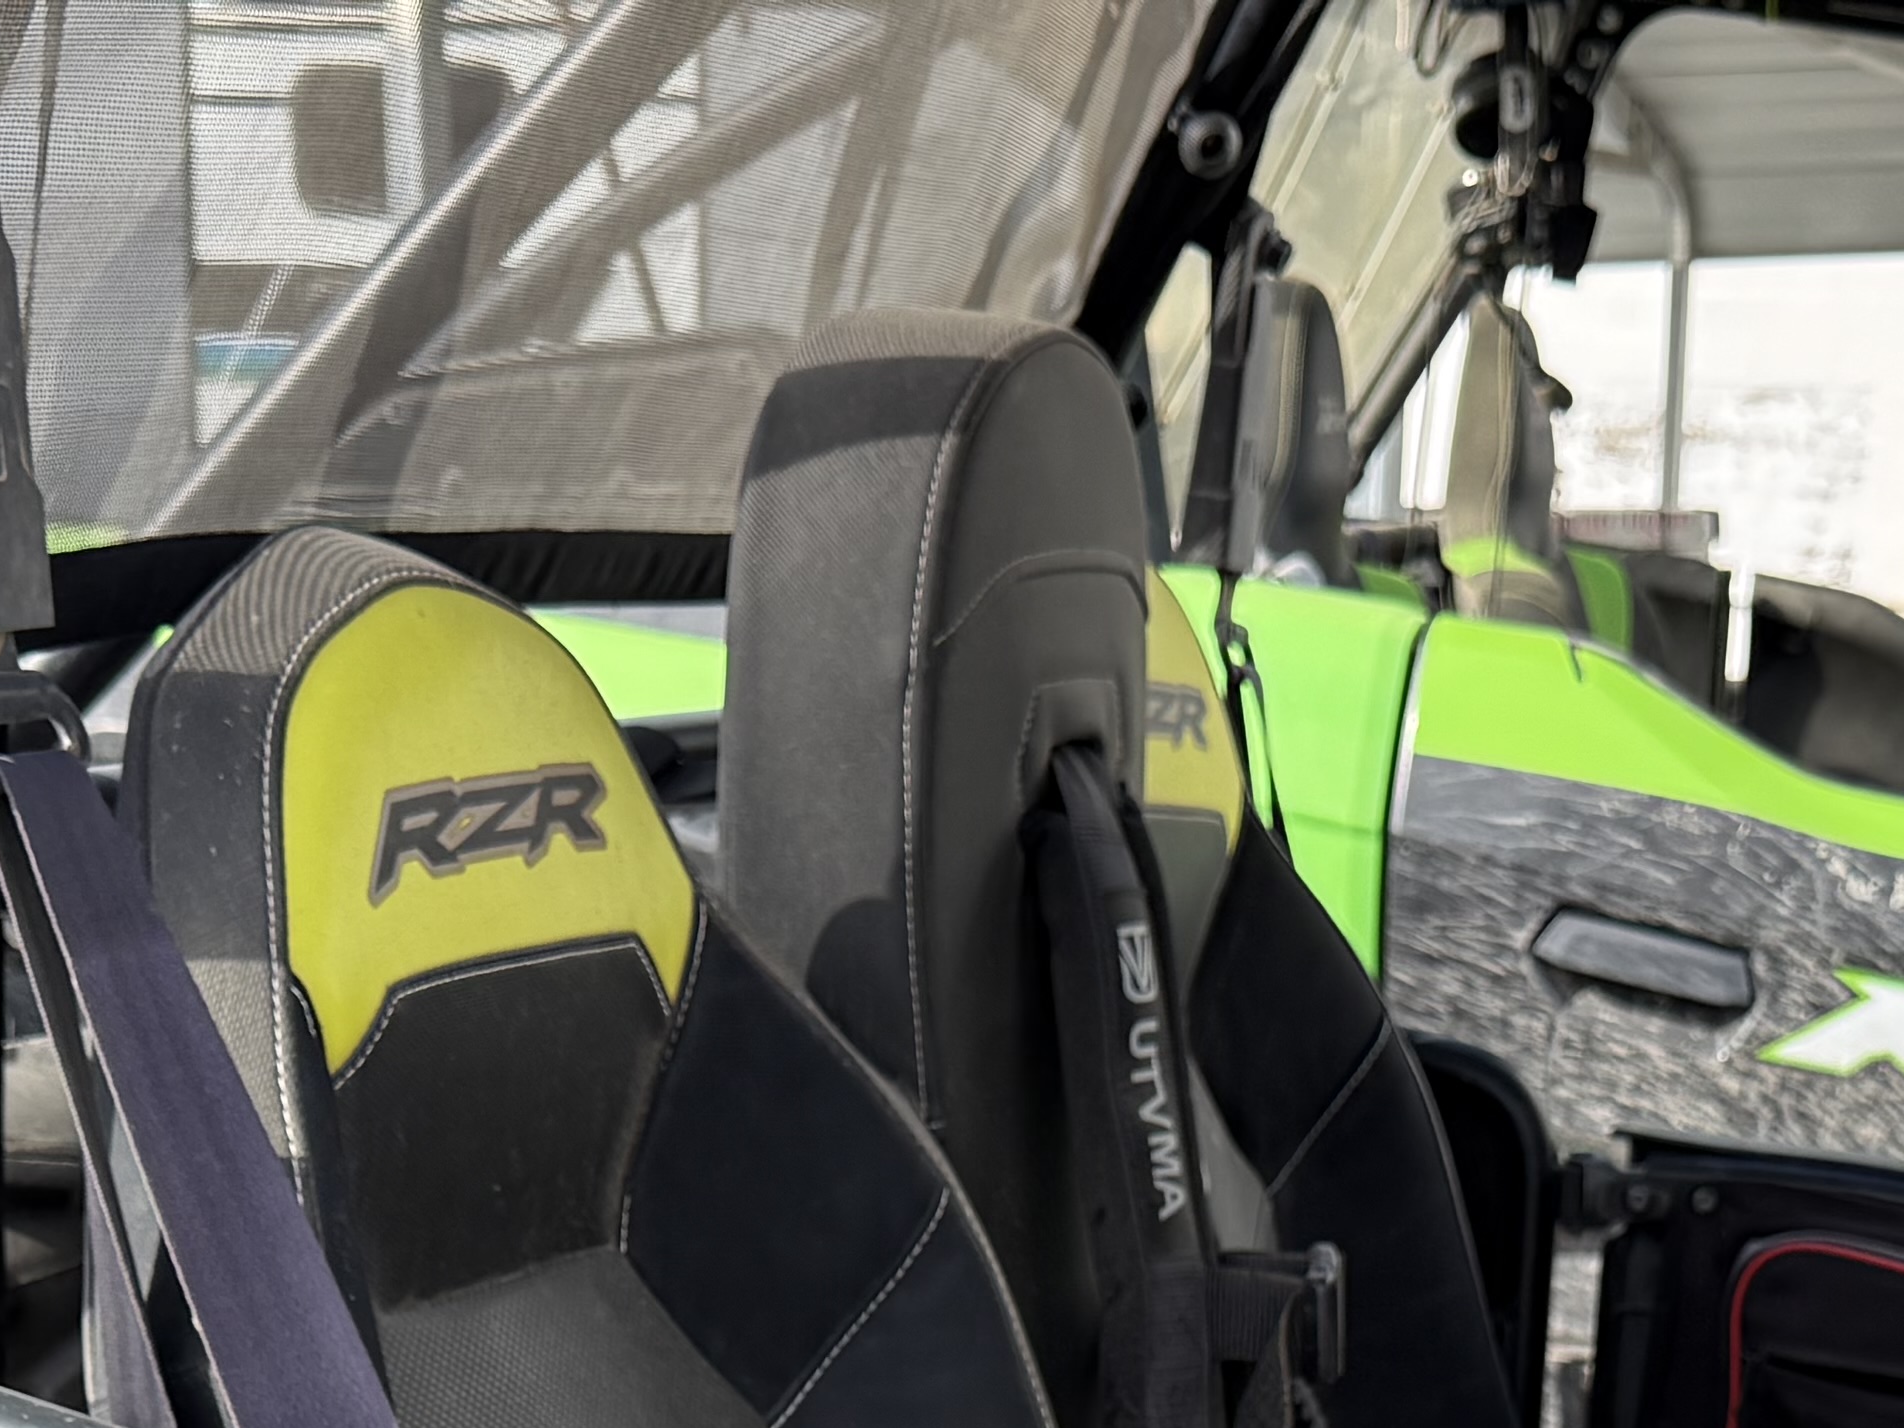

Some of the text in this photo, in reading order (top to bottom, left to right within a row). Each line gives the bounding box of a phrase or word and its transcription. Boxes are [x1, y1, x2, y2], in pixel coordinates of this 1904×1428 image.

[1144, 681, 1208, 752] ZR
[367, 762, 607, 909] RZR
[1129, 1020, 1187, 1223] UTVMA
